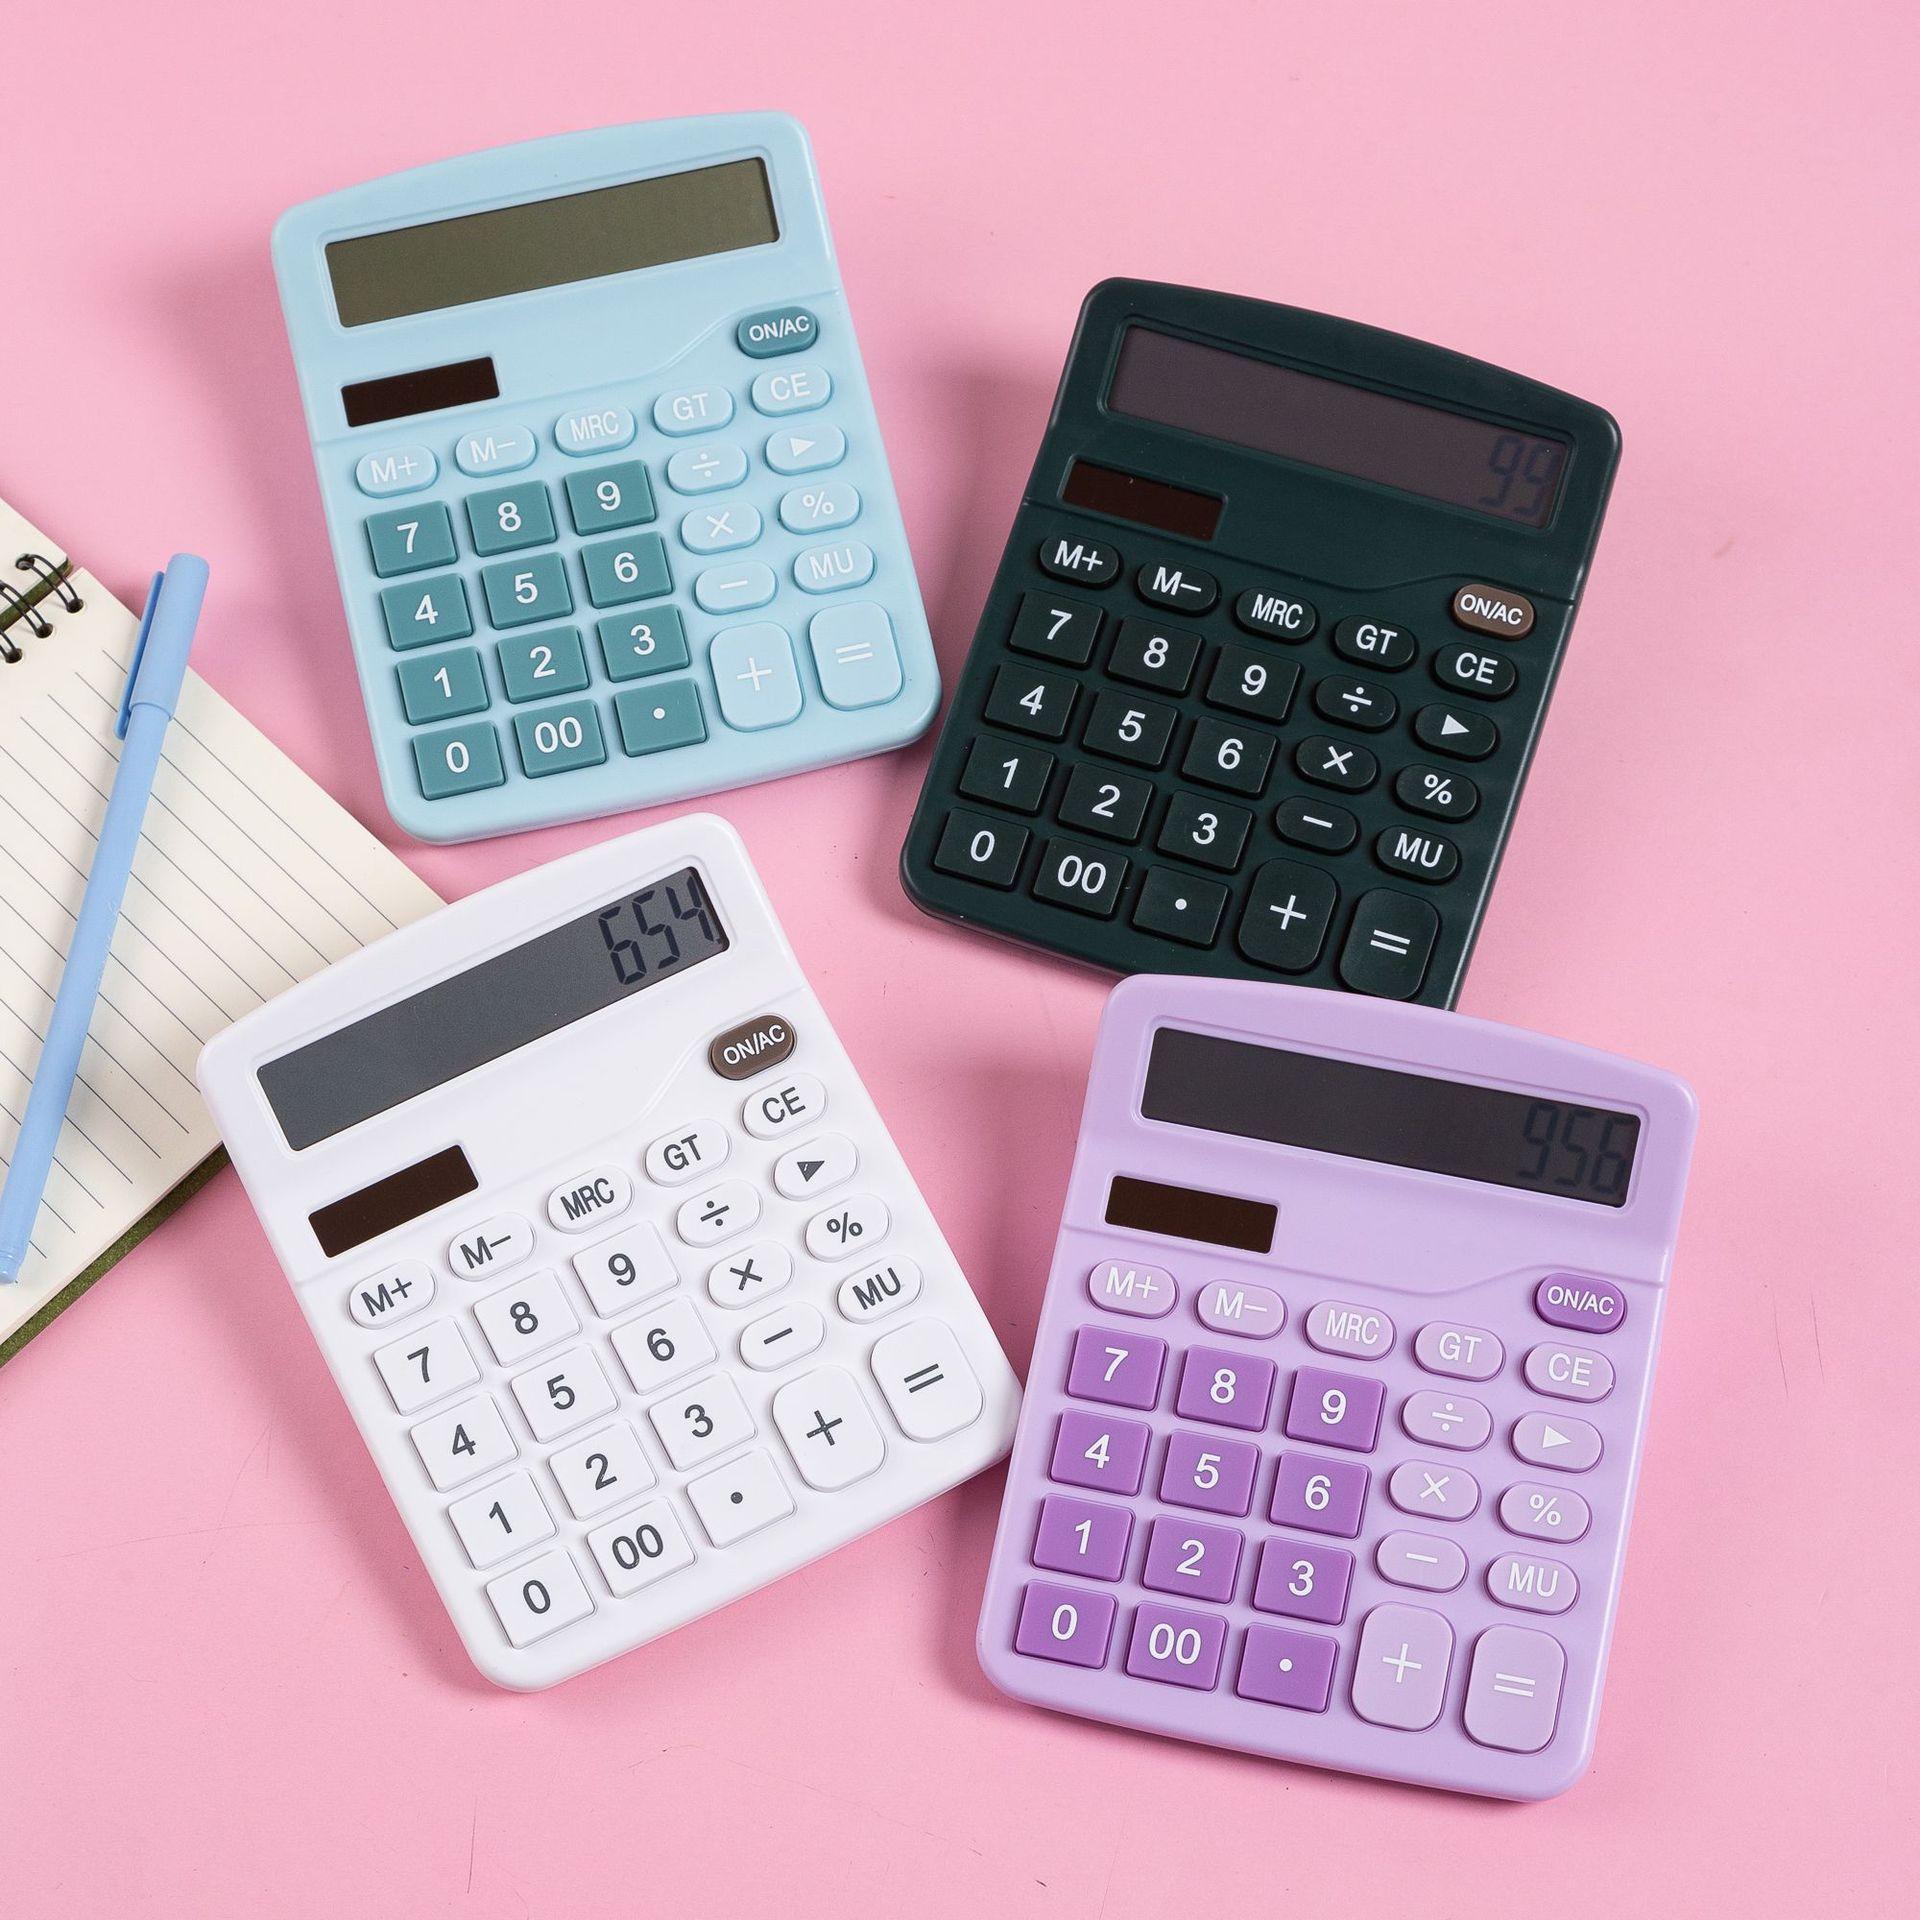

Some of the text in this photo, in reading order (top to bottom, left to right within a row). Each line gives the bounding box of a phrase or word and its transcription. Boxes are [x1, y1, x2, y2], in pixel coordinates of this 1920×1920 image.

[749, 314, 810, 341] ON/AC
[771, 373, 810, 400] CE
[673, 393, 708, 420] GT
[570, 411, 618, 441] MRC
[371, 456, 418, 483] M+
[597, 481, 620, 510] 9
[803, 492, 834, 518] %
[498, 502, 521, 531] 8
[397, 522, 418, 553] 7
[615, 553, 638, 582] 6
[810, 548, 853, 579] MU
[1055, 540, 1103, 571] M+
[516, 573, 537, 603] 5
[415, 595, 438, 624] 4
[1047, 610, 1072, 639] 7
[1252, 594, 1302, 628] MRC
[1461, 594, 1522, 624] ON/AC
[631, 625, 655, 655] 3
[1144, 638, 1168, 668] 8
[1356, 625, 1397, 654] GT
[530, 646, 555, 678] 2
[1456, 653, 1498, 684] CE
[434, 668, 451, 697] 1
[1242, 665, 1266, 695] 9
[1020, 686, 1044, 715] 4
[535, 717, 582, 752] 00
[1119, 710, 1145, 741] 5
[446, 742, 469, 772] 0
[1218, 739, 1243, 769] 6
[1003, 759, 1018, 788] 1
[1092, 785, 1120, 817] 2
[1425, 775, 1451, 804] %
[1193, 813, 1217, 844] 3
[971, 831, 995, 861] 0
[1395, 833, 1443, 867] MU
[1058, 856, 1106, 893] 00
[723, 1024, 786, 1067] ON/AC
[763, 1087, 805, 1123] CE
[664, 1134, 701, 1170] GT
[560, 1178, 614, 1220] MRC
[827, 1212, 862, 1243] %
[608, 1254, 636, 1286] 9
[1106, 1267, 1158, 1298] M+
[361, 1278, 412, 1317] M+
[852, 1268, 900, 1310] MU
[1547, 1285, 1615, 1316] ON/AC
[510, 1302, 538, 1334] 8
[1326, 1309, 1379, 1344] MRC
[647, 1329, 674, 1361] 6
[1440, 1332, 1482, 1362] GT
[407, 1347, 430, 1383] 7
[1105, 1347, 1128, 1381] 7
[1549, 1353, 1593, 1386] CE
[547, 1375, 575, 1409] 5
[1211, 1369, 1235, 1403] 8
[685, 1405, 713, 1437] 3
[1321, 1390, 1346, 1424] 9
[452, 1424, 476, 1455] 4
[1085, 1435, 1109, 1468] 4
[586, 1454, 617, 1490] 2
[1194, 1454, 1220, 1488] 5
[1306, 1475, 1330, 1510] 6
[489, 1502, 512, 1533] 1
[1530, 1495, 1561, 1525] %
[612, 1524, 663, 1569] 00
[1076, 1520, 1091, 1554] 1
[1177, 1540, 1204, 1576] 2
[1289, 1561, 1314, 1595] 3
[1509, 1562, 1558, 1596] MU
[523, 1580, 550, 1614] 0
[1052, 1605, 1077, 1640] 0
[1150, 1624, 1201, 1664] 00
